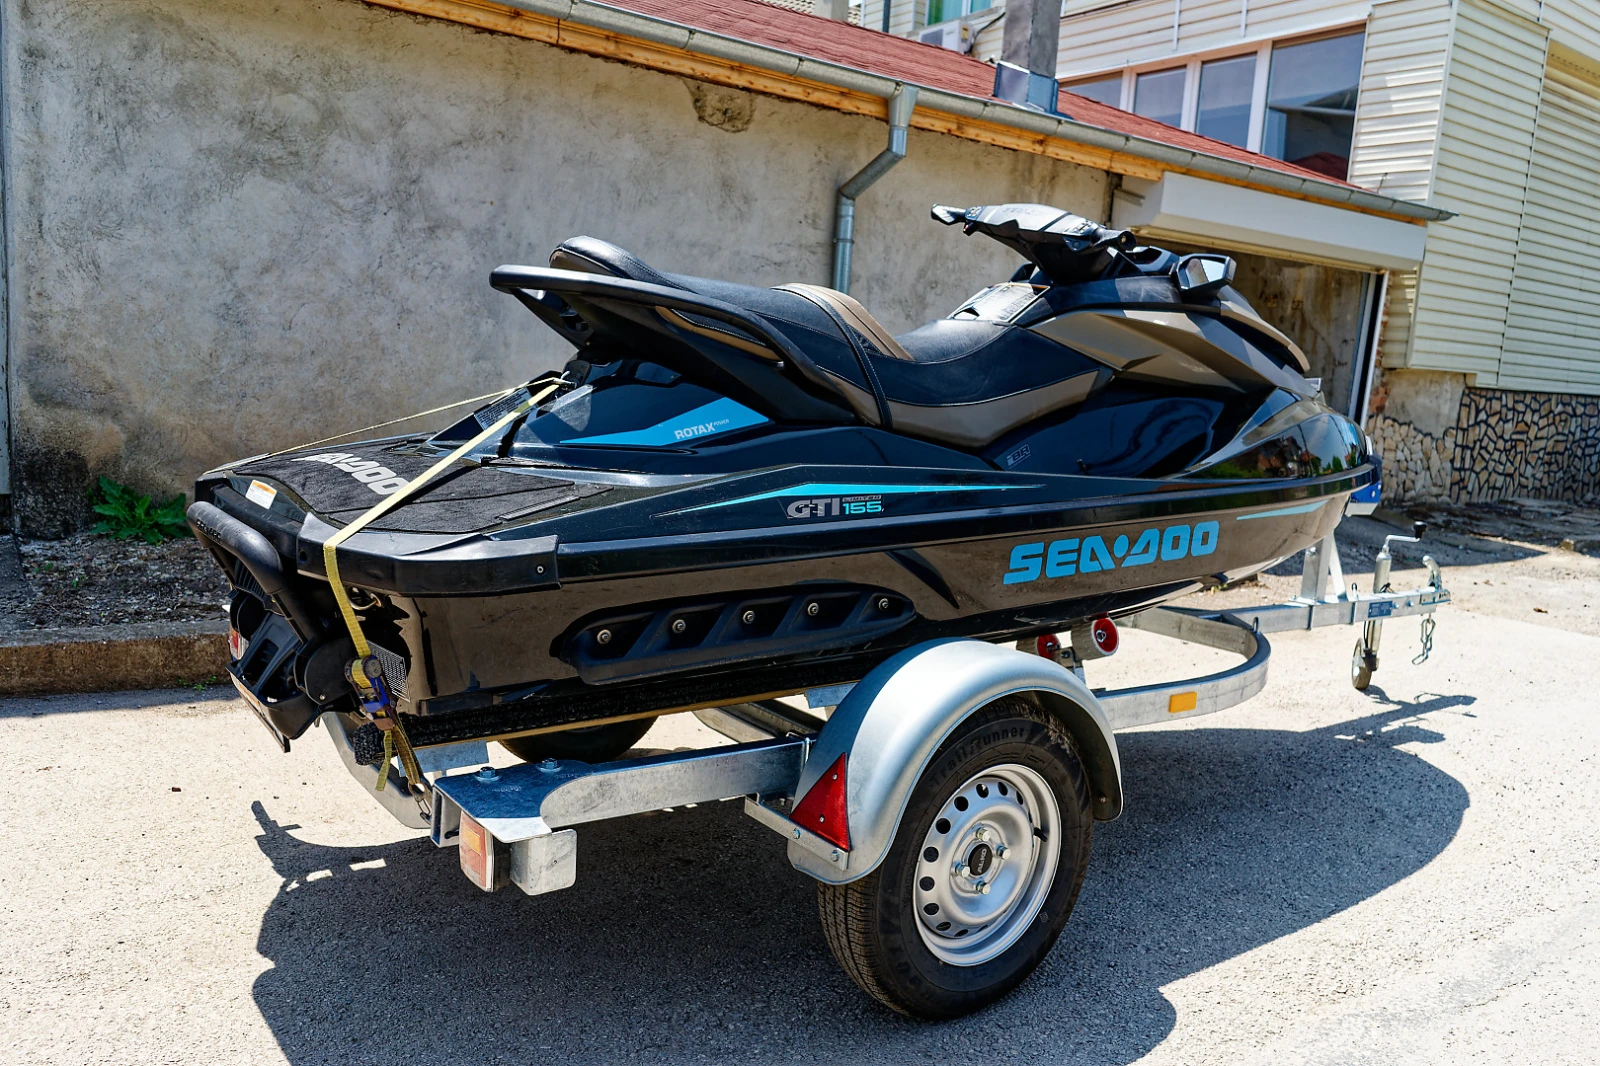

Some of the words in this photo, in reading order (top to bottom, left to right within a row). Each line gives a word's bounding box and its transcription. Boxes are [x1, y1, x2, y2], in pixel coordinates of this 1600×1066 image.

[674, 422, 715, 440] ROTAX
[786, 497, 840, 519] GTI
[842, 500, 882, 515] 155
